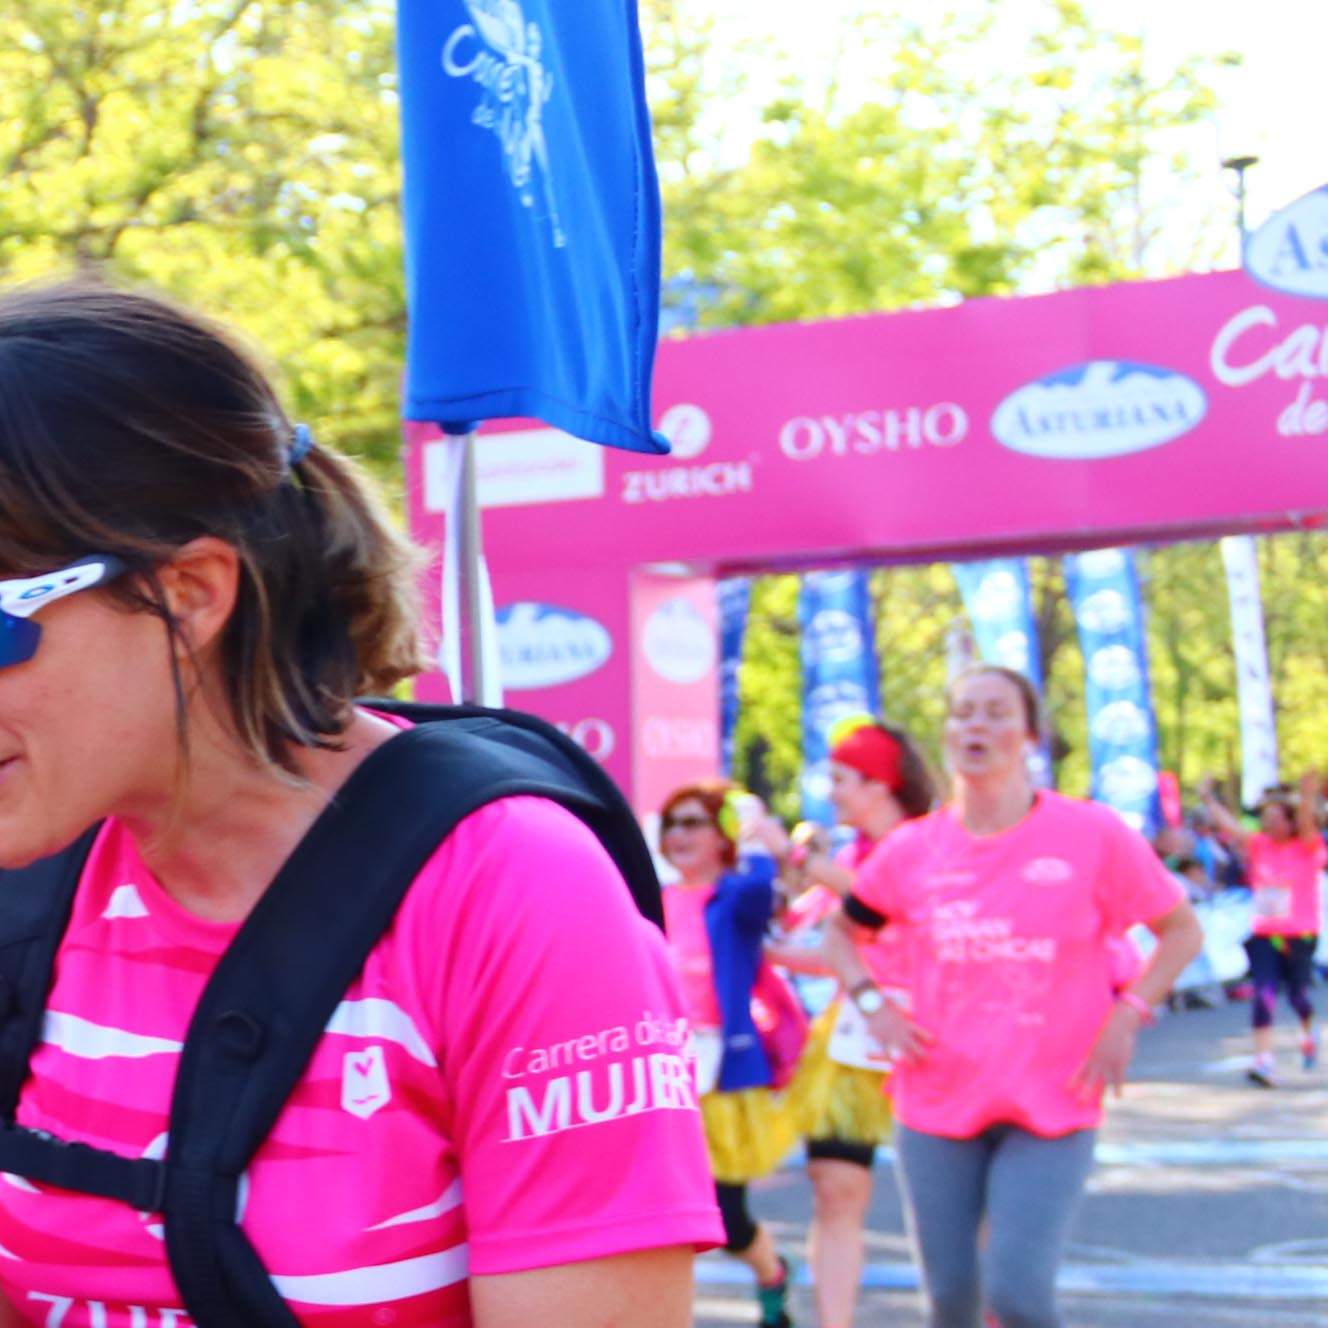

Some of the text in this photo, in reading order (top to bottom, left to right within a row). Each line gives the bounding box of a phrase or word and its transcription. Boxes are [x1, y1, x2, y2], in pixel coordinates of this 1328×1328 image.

[779, 402, 969, 461] OYSHO
[622, 461, 752, 503] ZURICH
[501, 1025, 629, 1078] Carrera
[507, 1052, 698, 1140] MUJER
